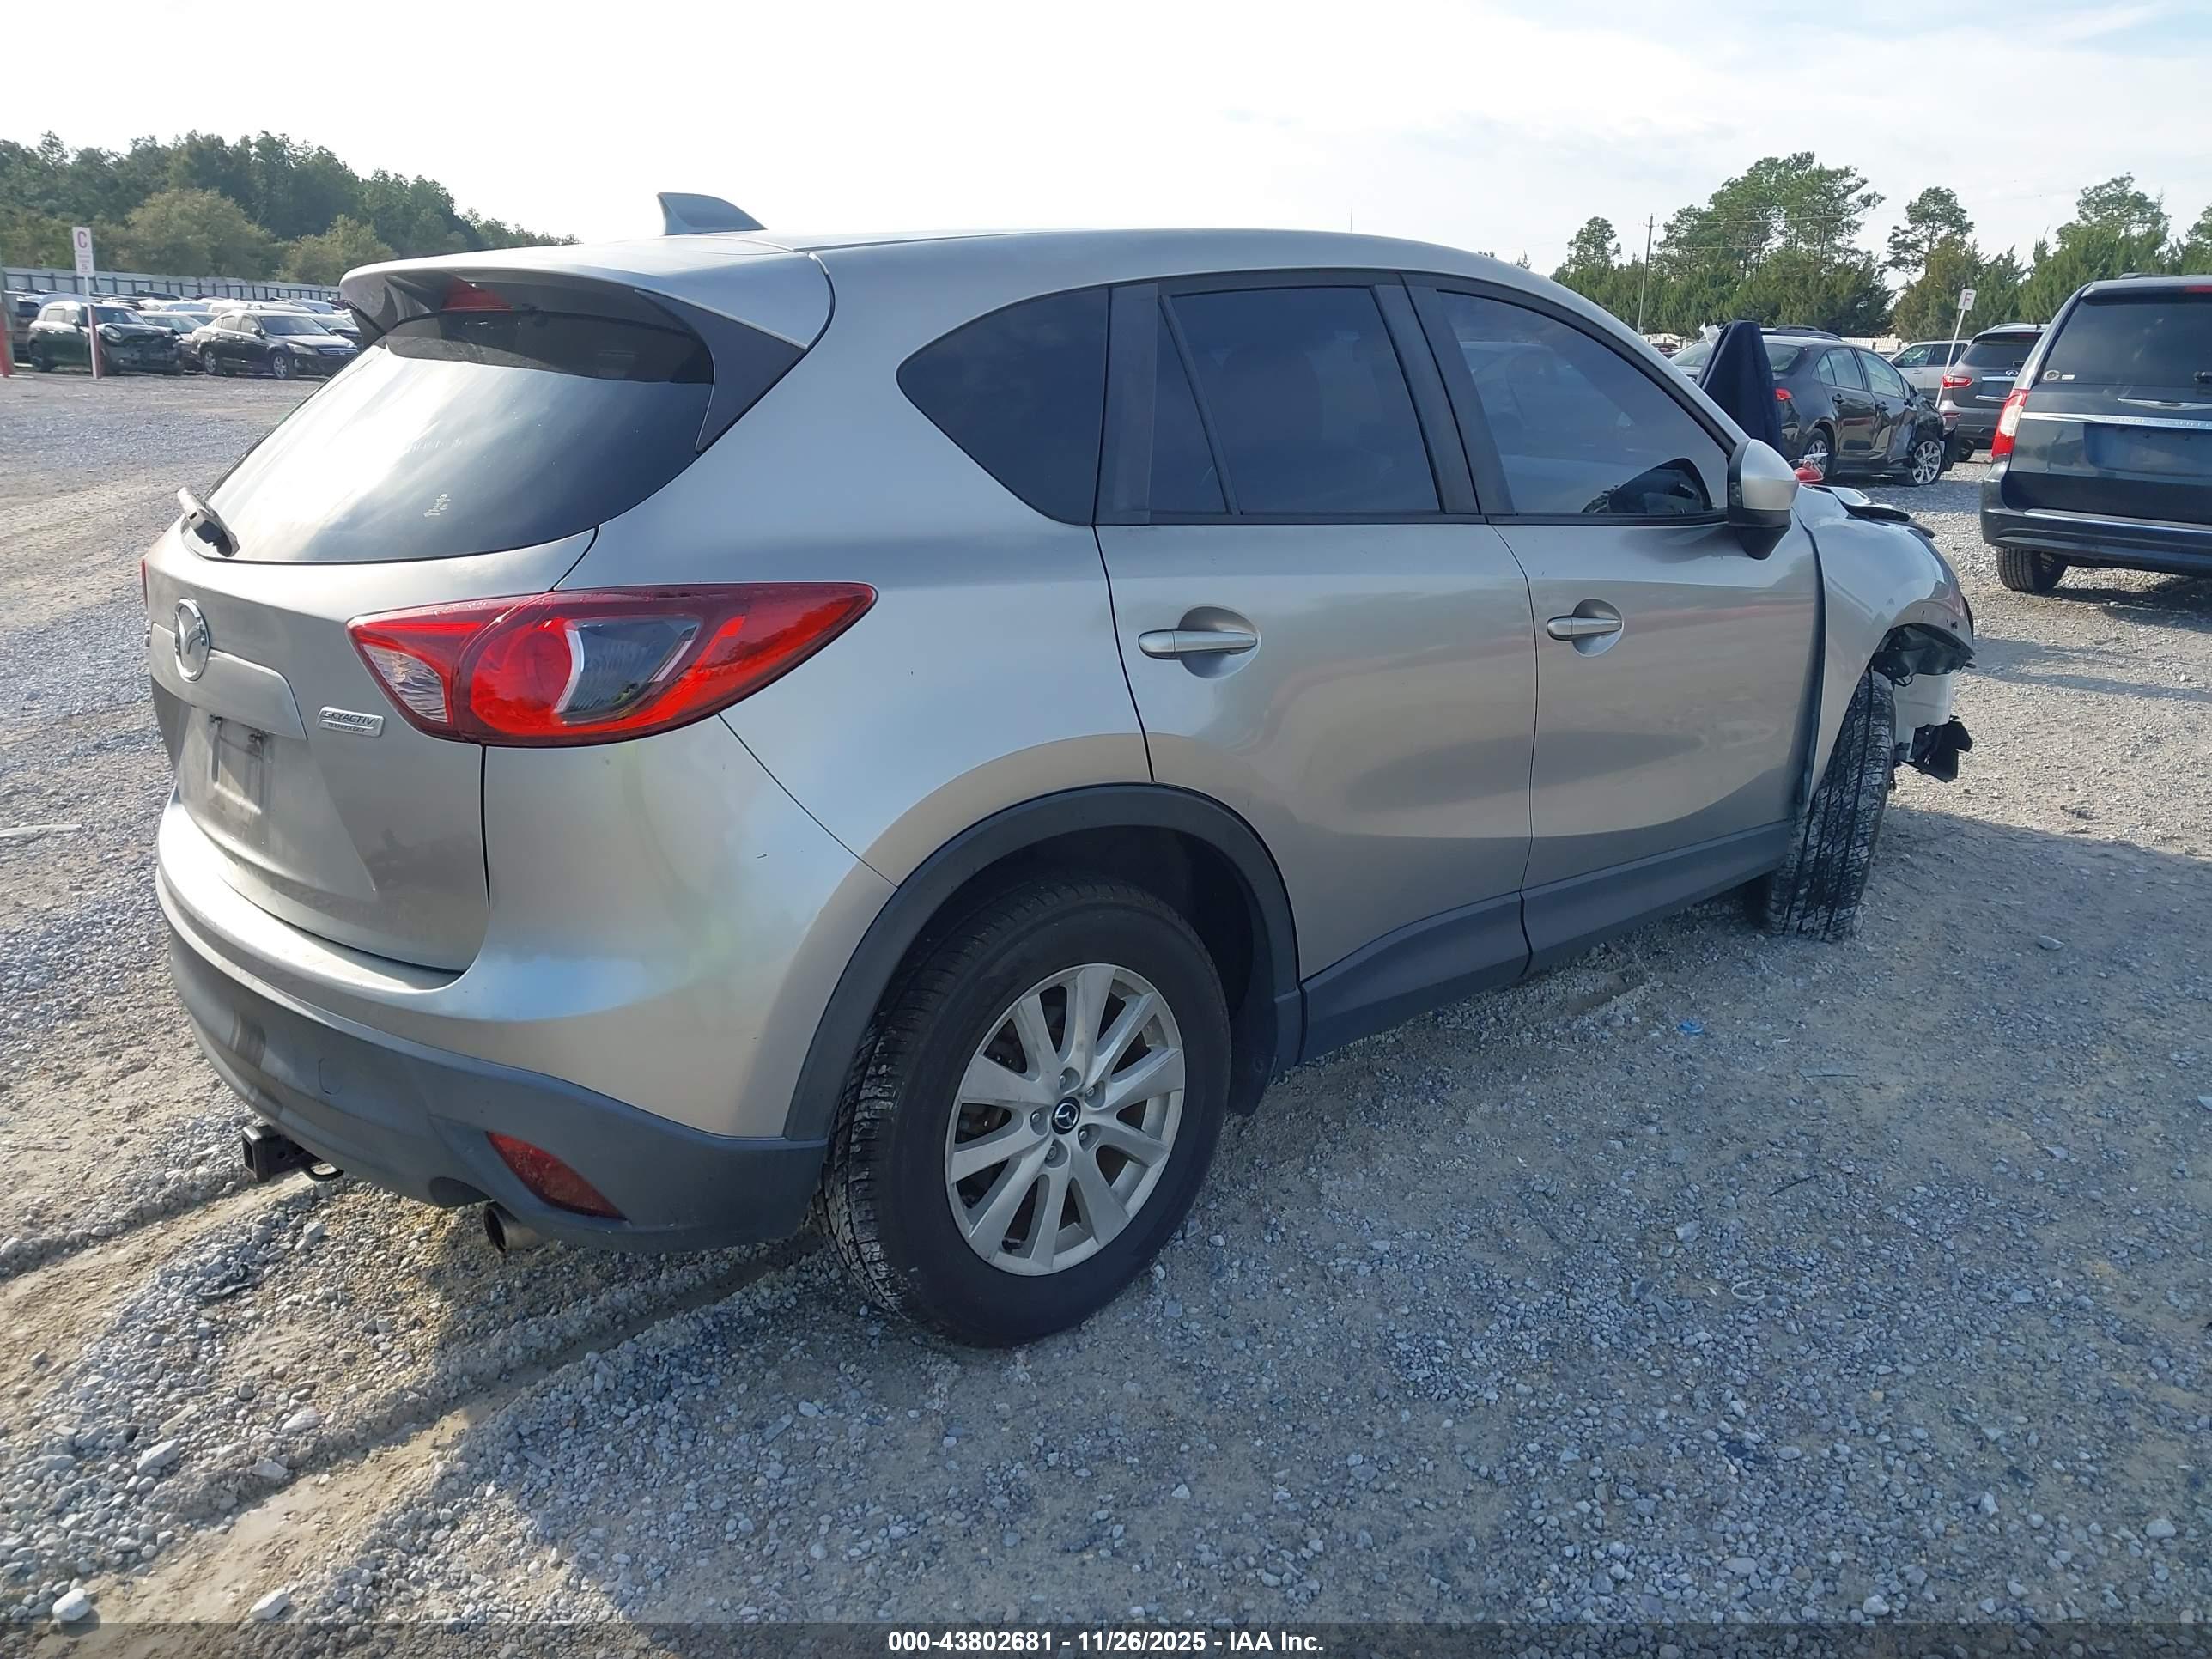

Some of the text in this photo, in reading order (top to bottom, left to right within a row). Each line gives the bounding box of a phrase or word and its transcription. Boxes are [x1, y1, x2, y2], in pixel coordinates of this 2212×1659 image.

[77, 230, 88, 248] C
[1962, 292, 1972, 307] F
[322, 710, 376, 726] SKYACTIV
